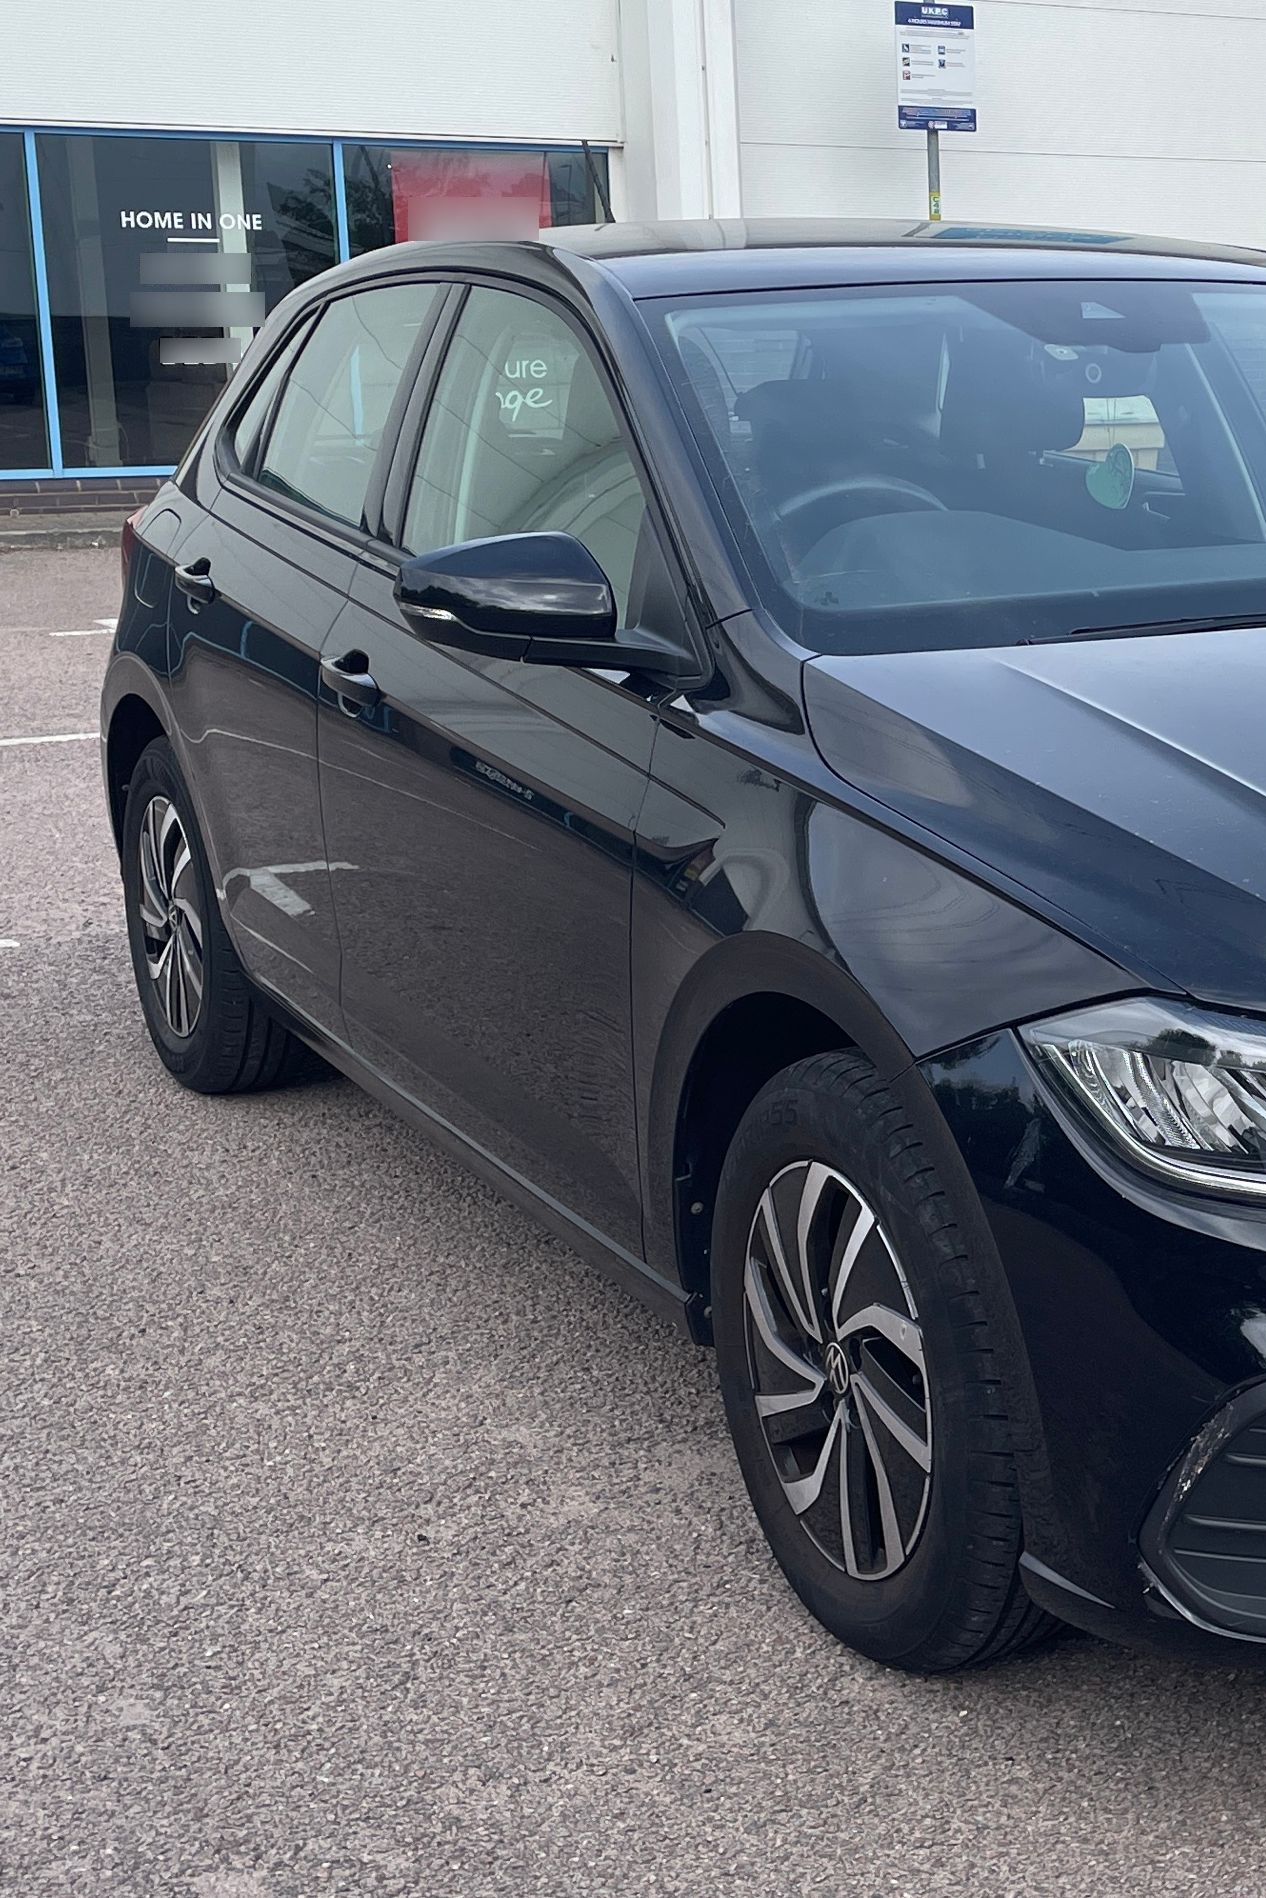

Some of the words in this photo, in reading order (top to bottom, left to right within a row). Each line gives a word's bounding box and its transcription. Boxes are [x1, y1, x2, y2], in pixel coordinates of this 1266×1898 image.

[120, 211, 184, 229] HOME
[191, 212, 212, 230] IN
[219, 213, 263, 231] ONE
